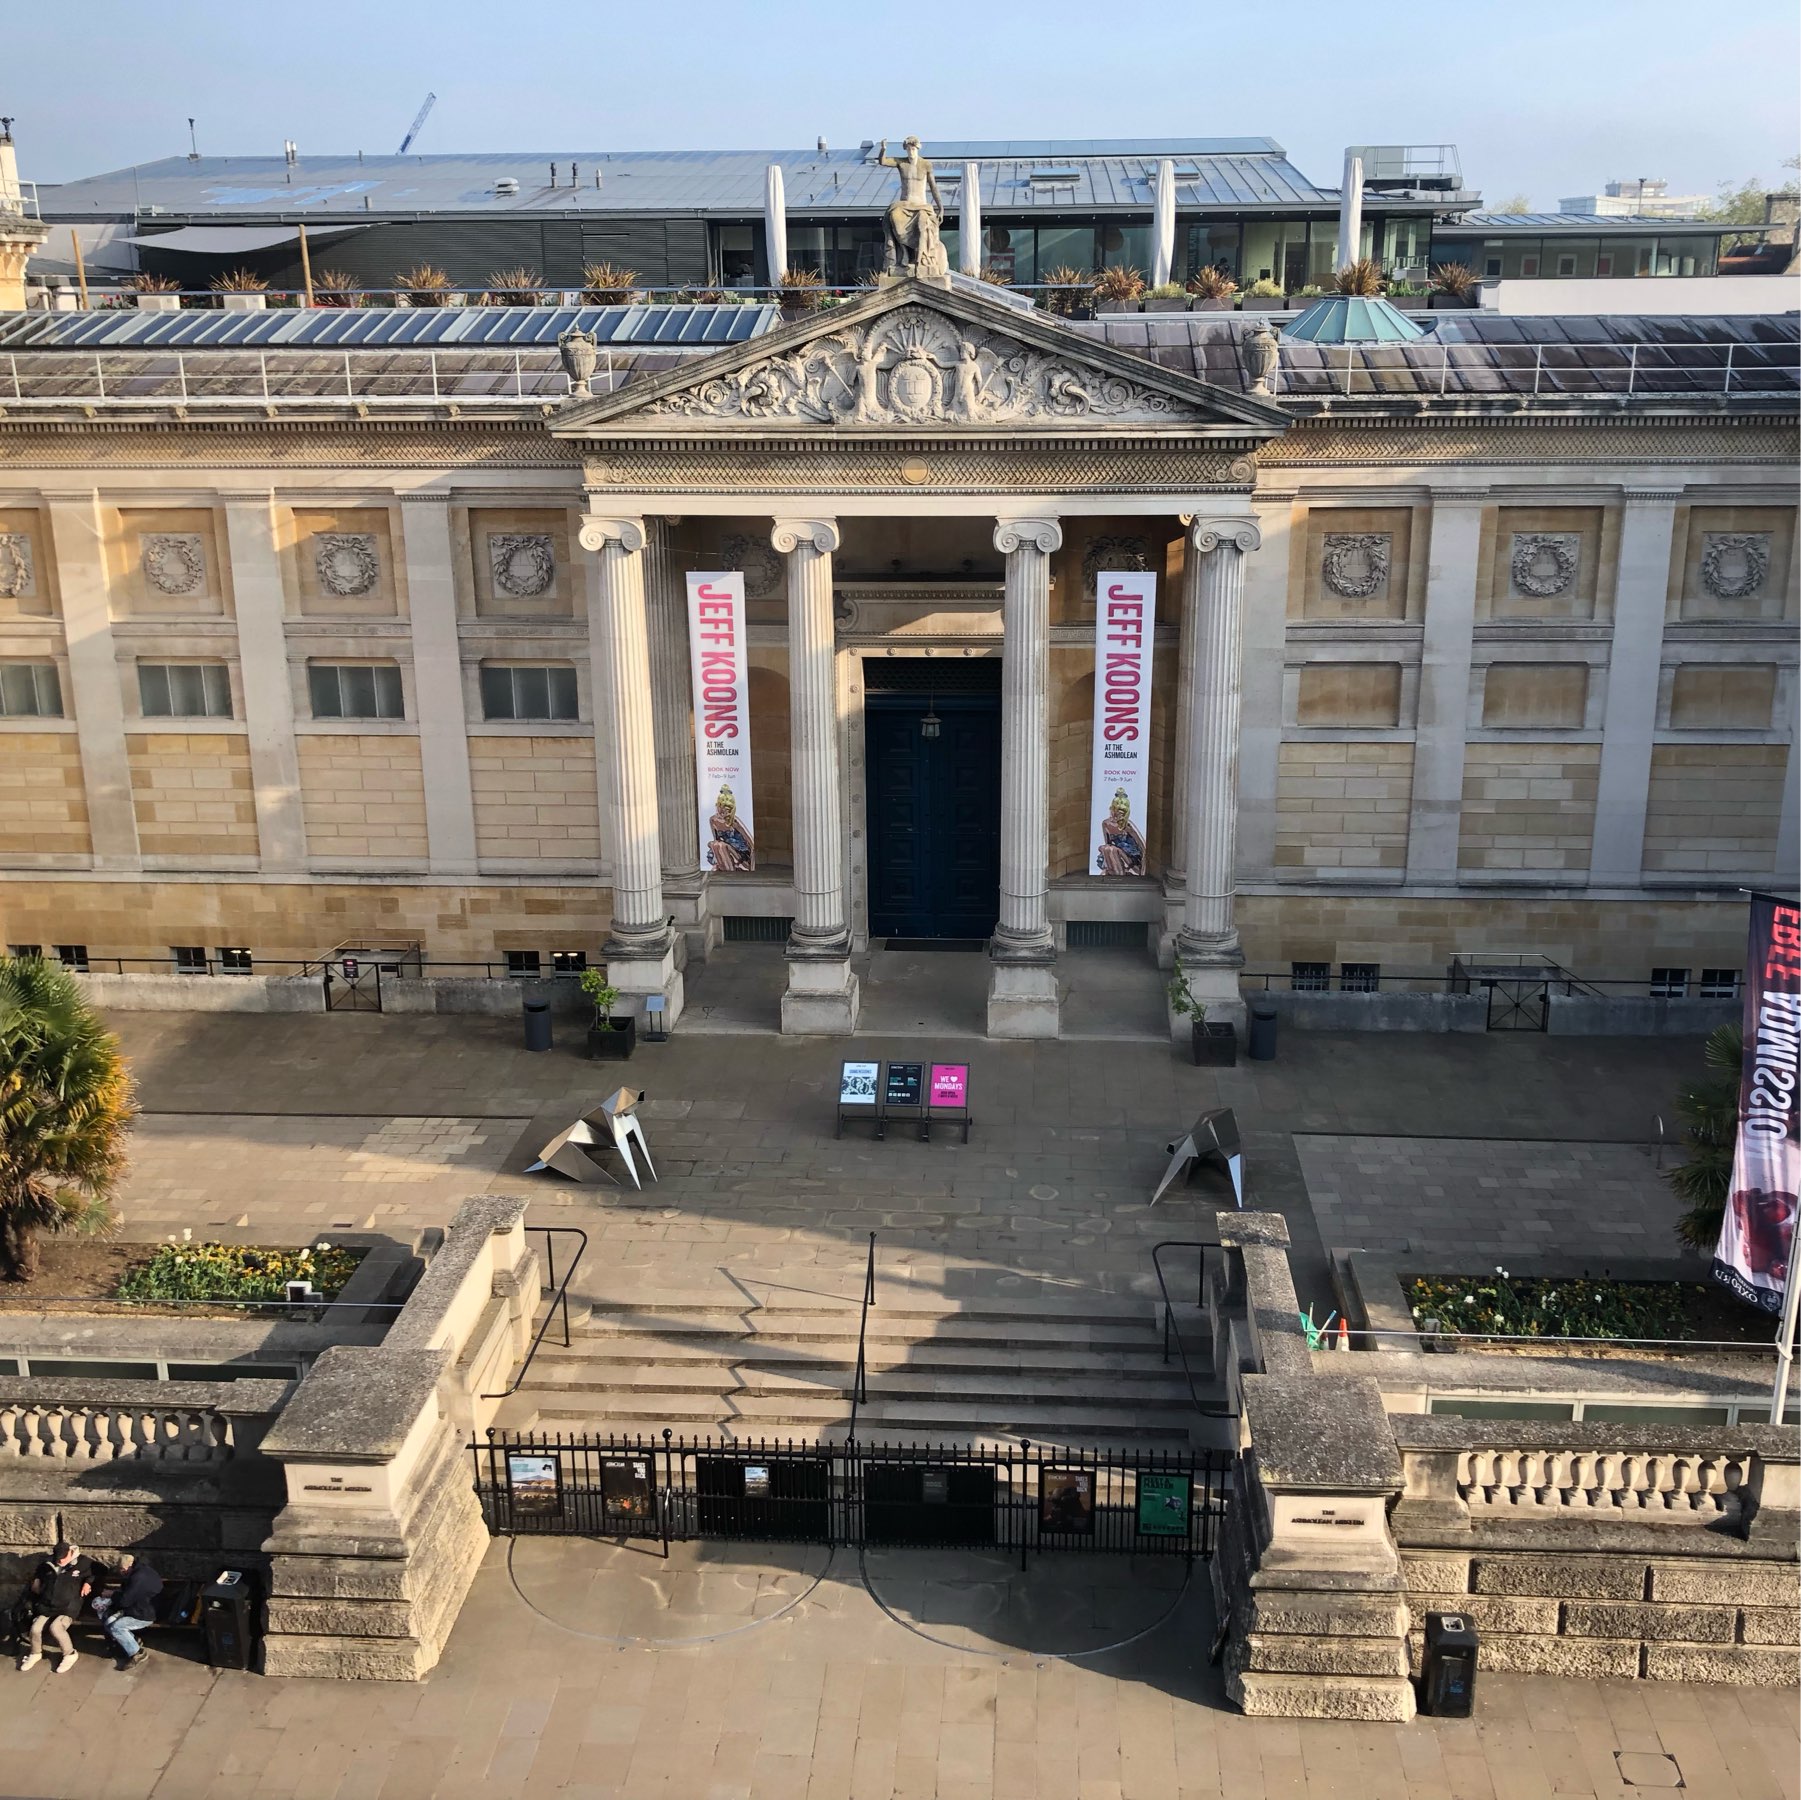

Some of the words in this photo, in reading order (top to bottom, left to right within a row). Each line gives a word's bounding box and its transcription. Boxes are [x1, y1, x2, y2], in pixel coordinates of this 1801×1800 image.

[697, 584, 735, 646] JEFF
[1106, 584, 1144, 648] JEFF
[701, 651, 739, 739] KOONS
[1103, 653, 1141, 741] KOONS
[1104, 751, 1138, 759] ASHMOLEAN
